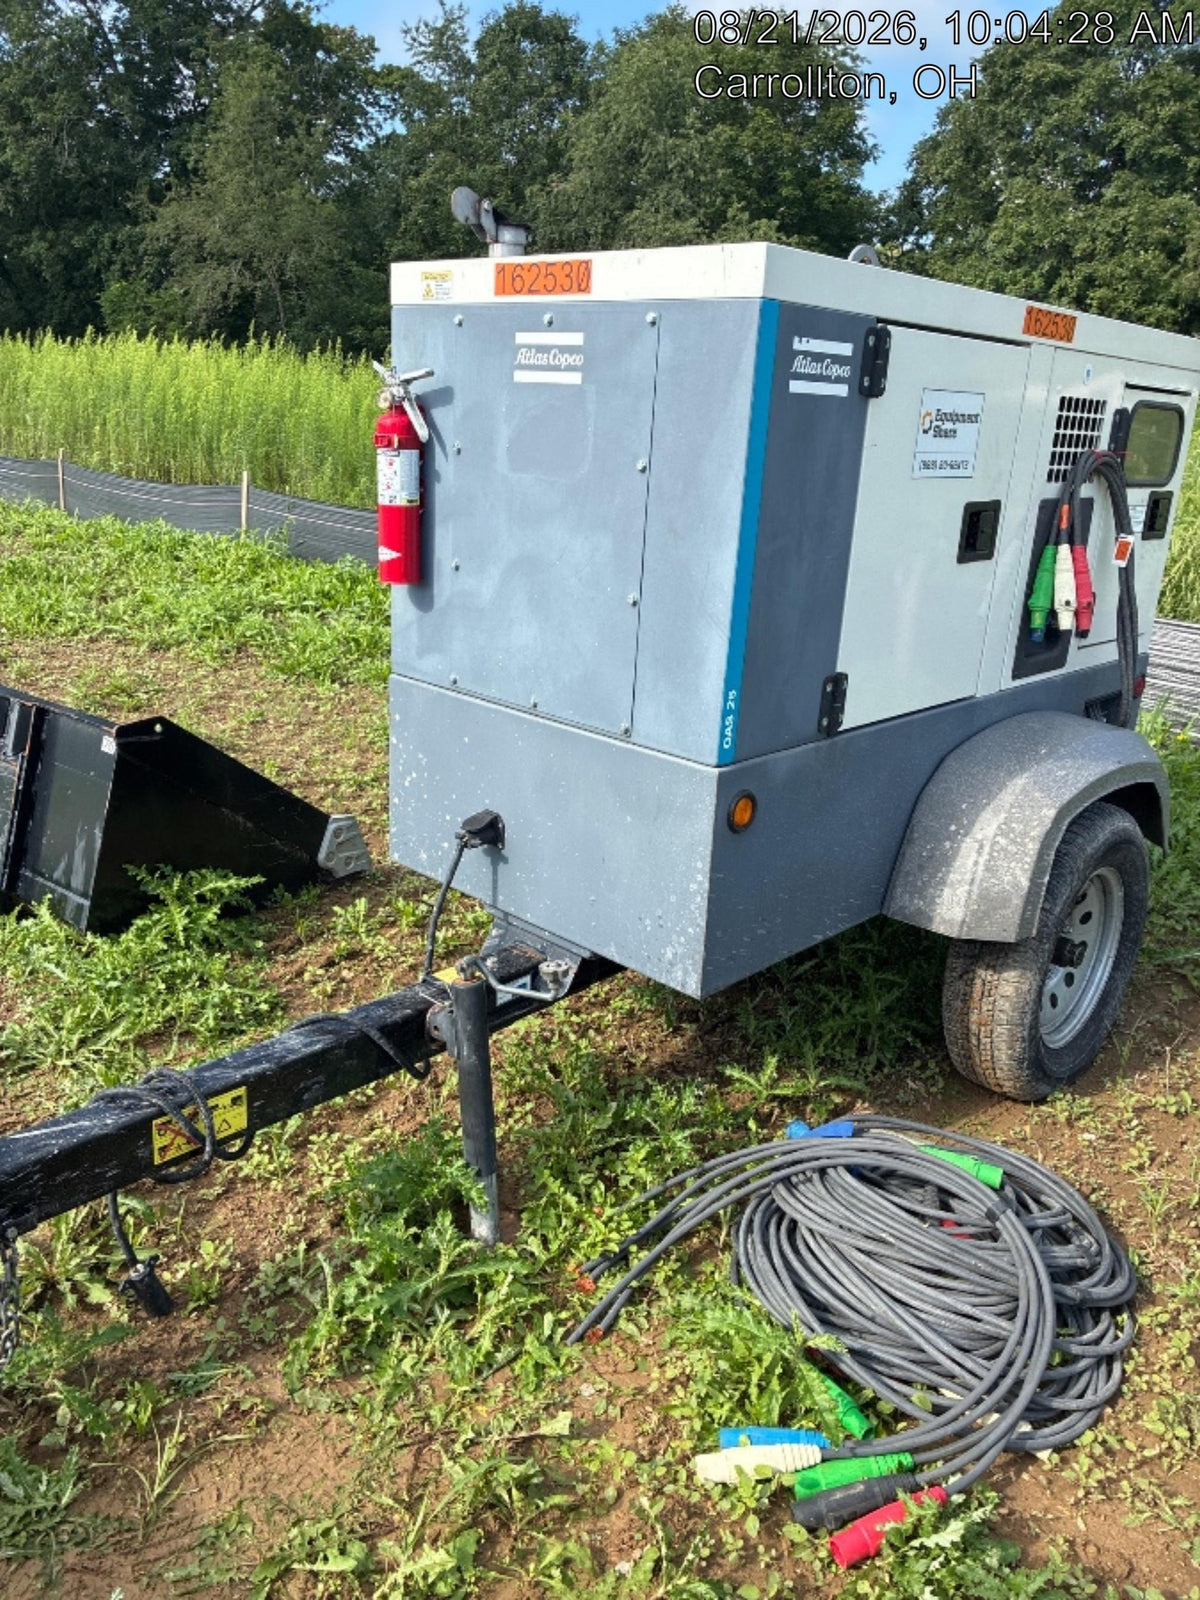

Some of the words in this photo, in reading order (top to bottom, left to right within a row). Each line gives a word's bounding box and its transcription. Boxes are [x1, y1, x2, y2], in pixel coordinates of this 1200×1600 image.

[496, 260, 591, 294] 162530
[514, 347, 548, 366] Atlas
[549, 348, 584, 370] Copco
[790, 354, 822, 375] Atlas
[823, 358, 851, 380] Copco
[935, 408, 980, 426] Equipment
